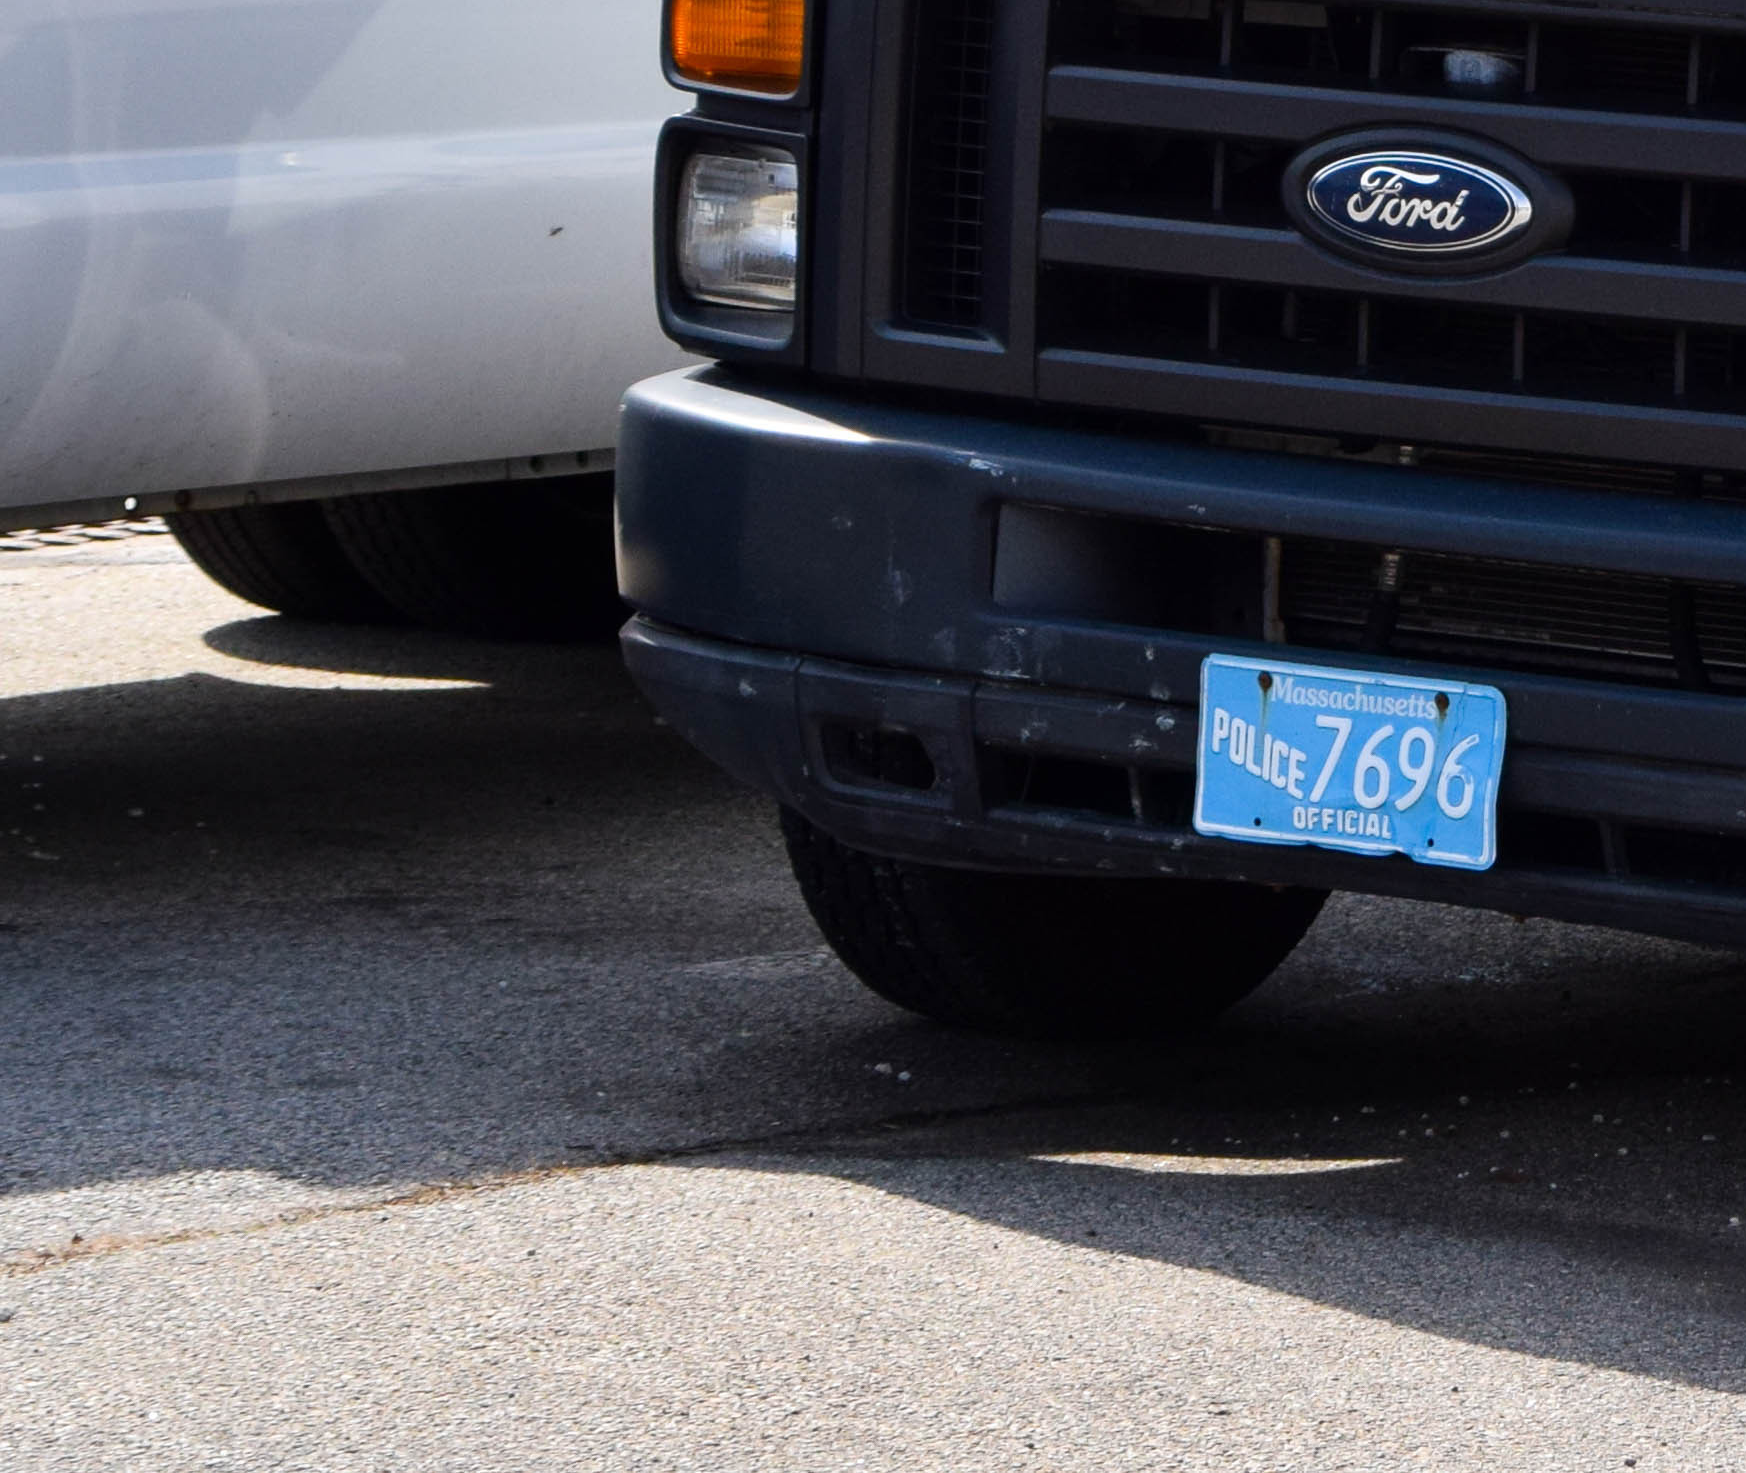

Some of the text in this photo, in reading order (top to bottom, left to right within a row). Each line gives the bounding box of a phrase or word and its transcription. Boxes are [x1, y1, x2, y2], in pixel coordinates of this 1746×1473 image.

[1347, 166, 1470, 231] Ford
[1271, 674, 1438, 719] Massachusetts
[1211, 707, 1480, 820] POLICE 7696
[1293, 806, 1392, 839] OFFICIAL
